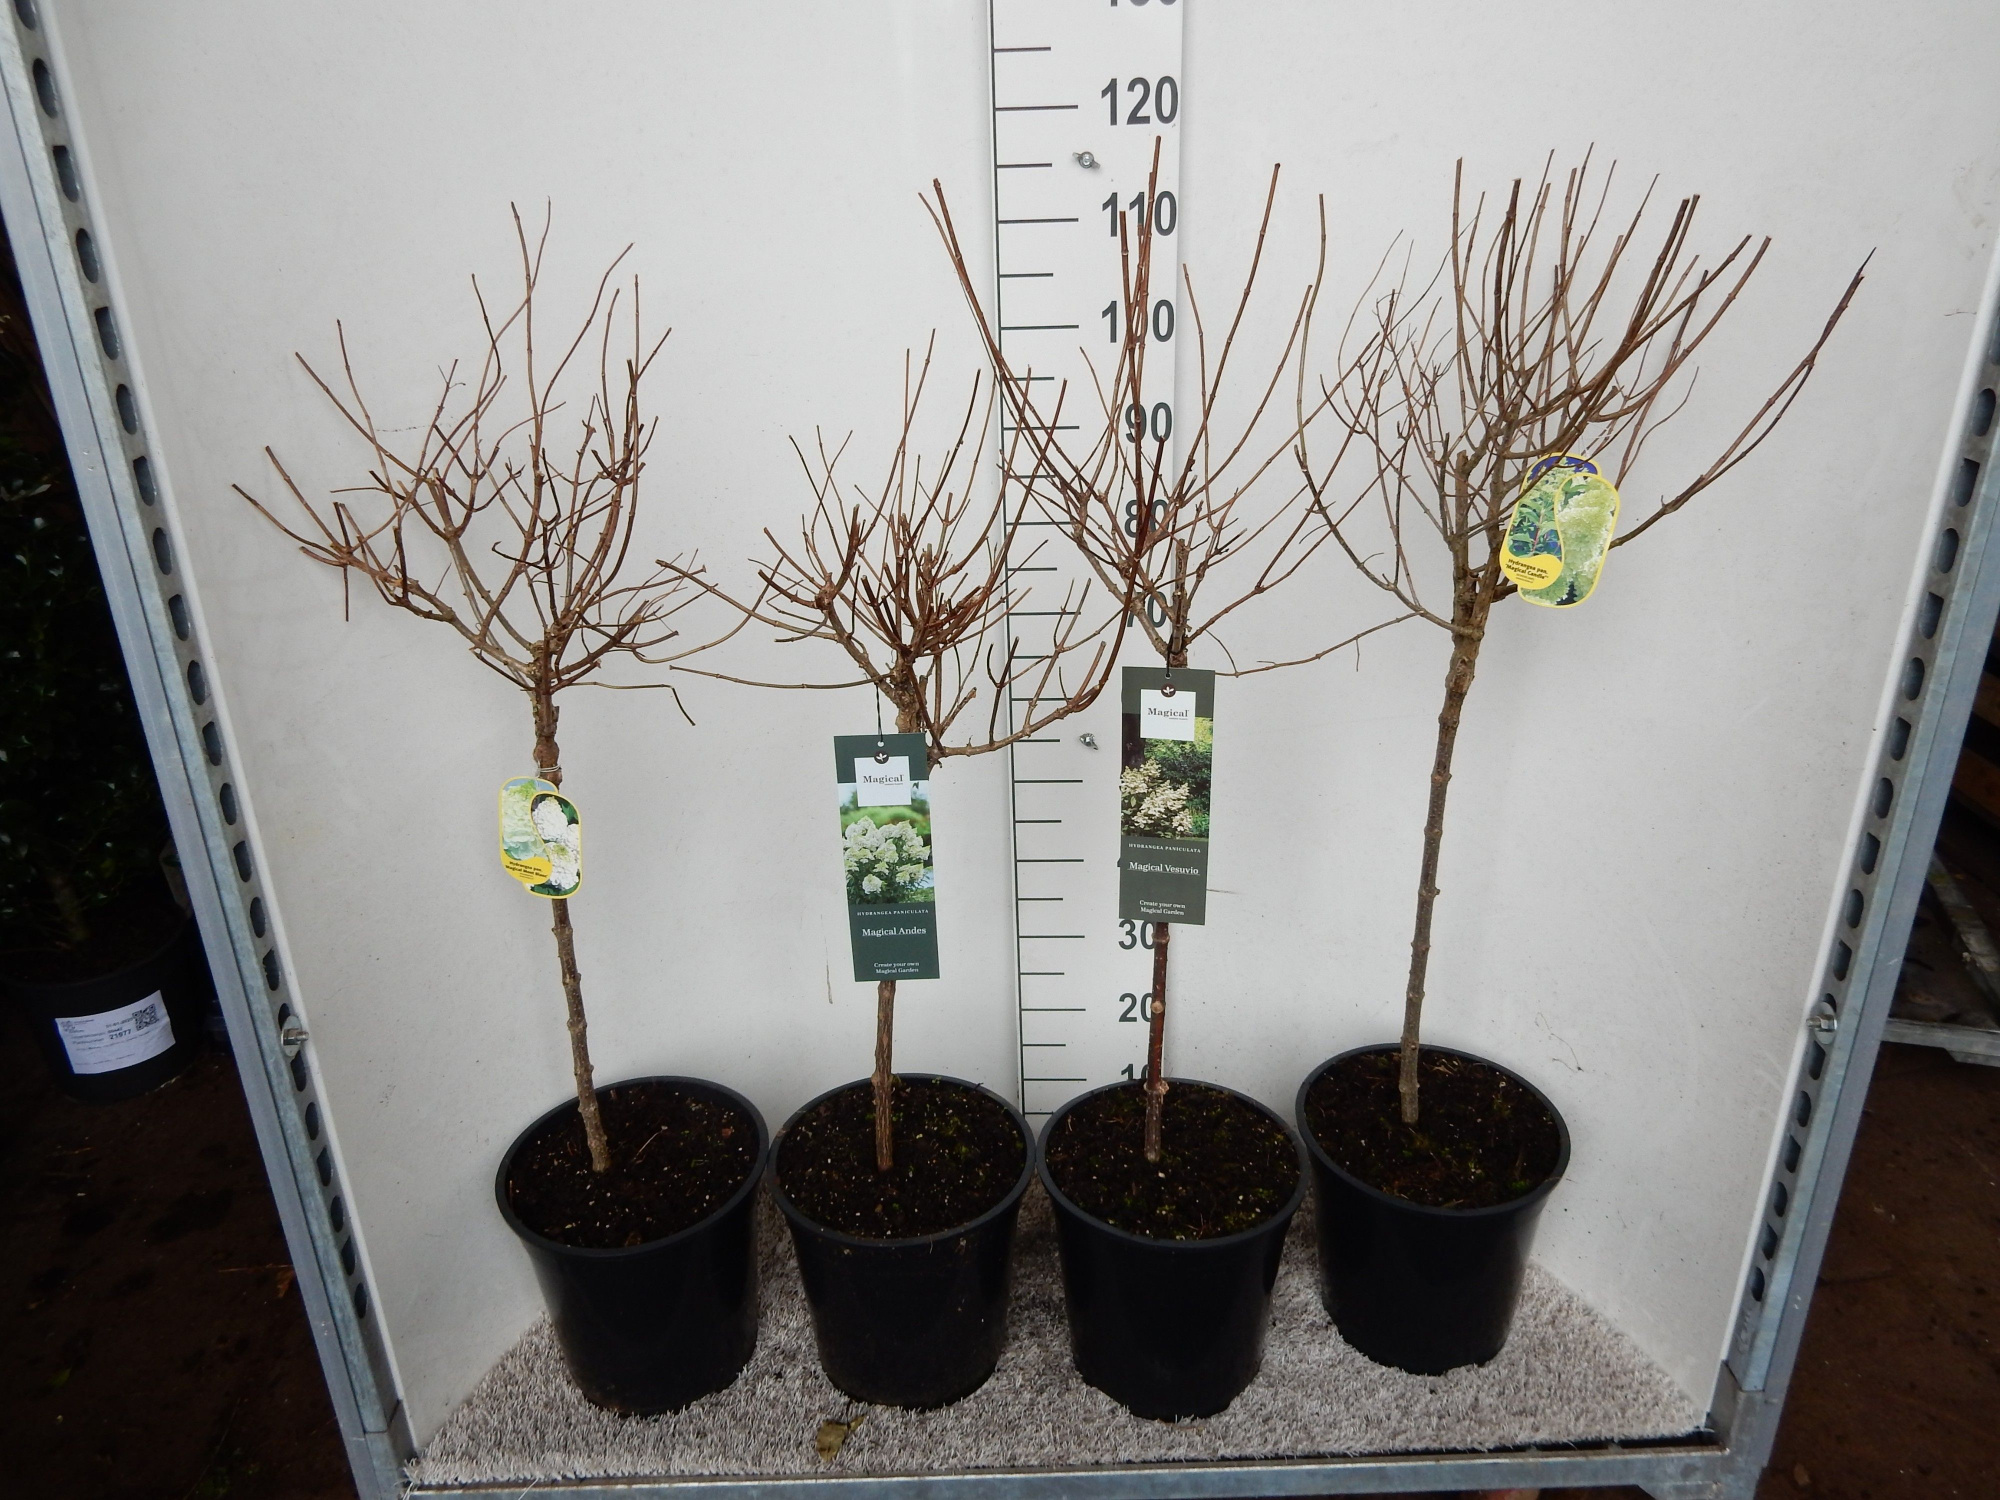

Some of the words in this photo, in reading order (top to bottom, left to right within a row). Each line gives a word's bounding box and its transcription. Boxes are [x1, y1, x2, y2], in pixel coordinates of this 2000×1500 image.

[1101, 76, 1178, 126] 120
[1102, 300, 1175, 343] 10
[1125, 402, 1172, 443] 90
[1508, 559, 1536, 571] Hydrangea
[1148, 707, 1188, 717] Magical
[863, 774, 903, 784] Magical
[1129, 861, 1163, 872] Magical
[1165, 864, 1199, 874] Vesuvio
[862, 927, 897, 937] Magical
[899, 926, 927, 935] Andes
